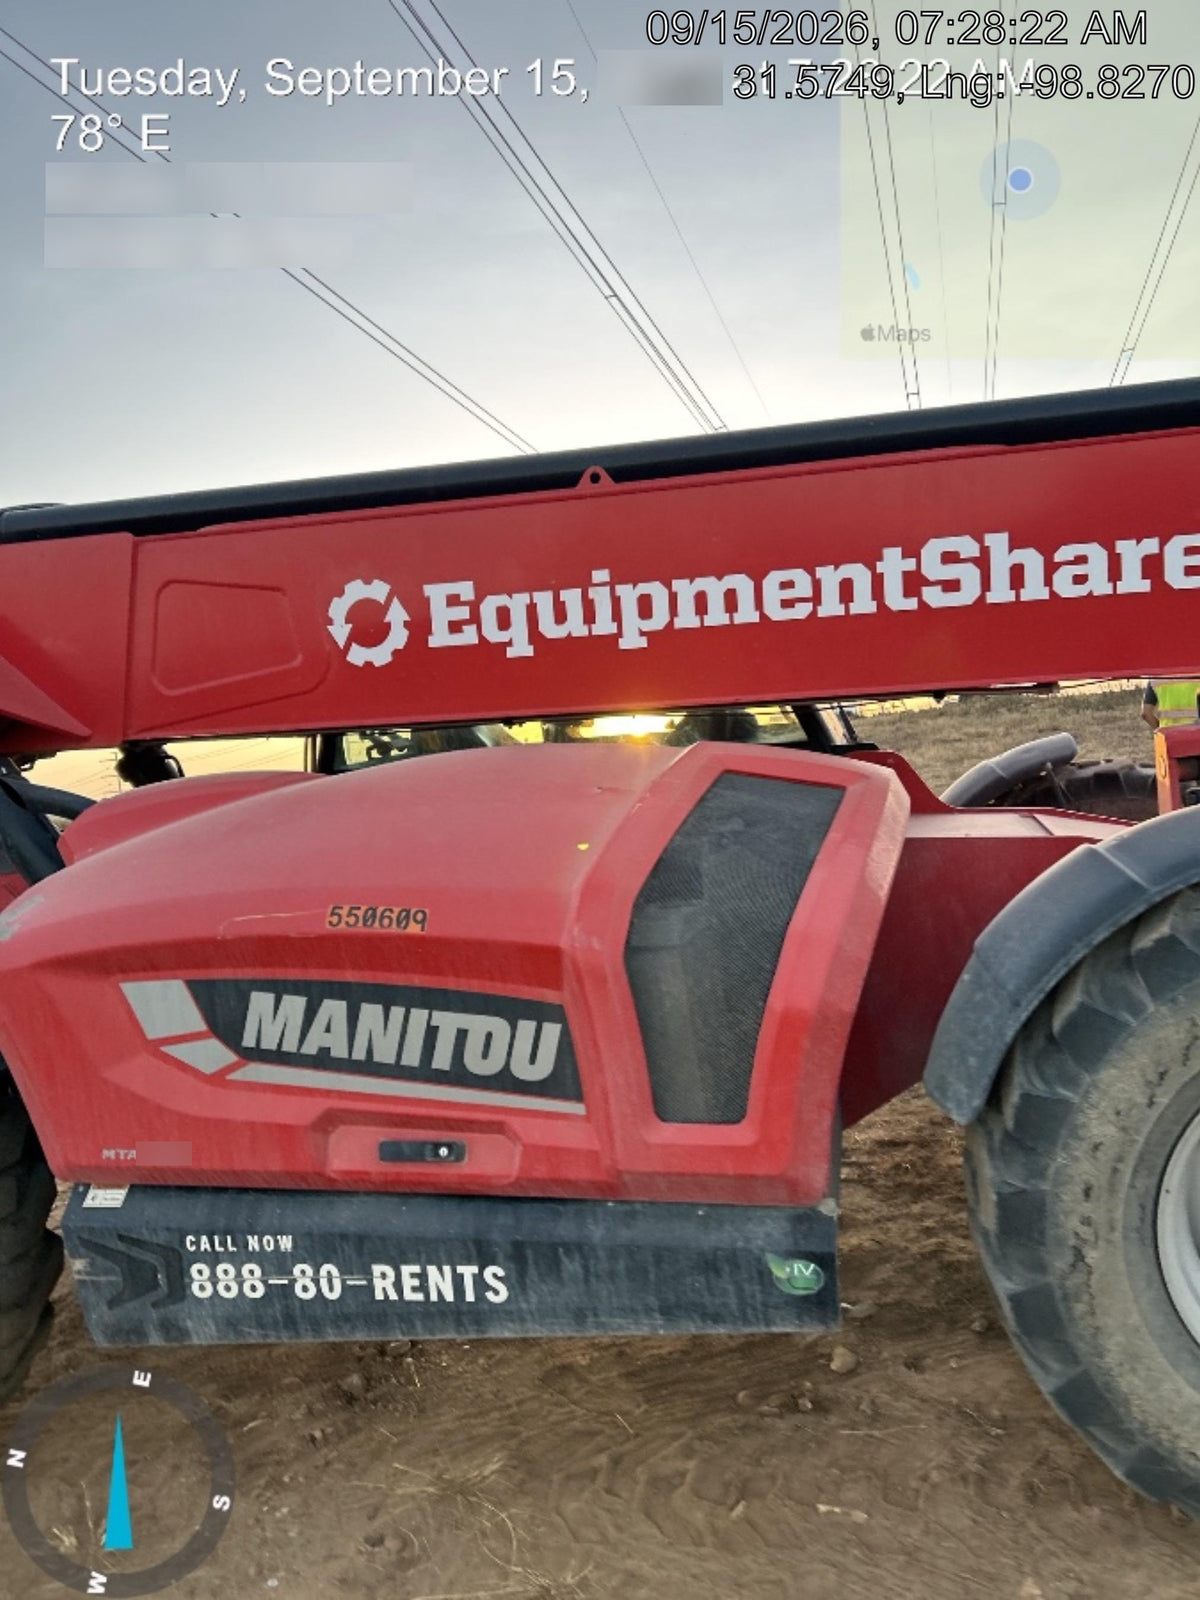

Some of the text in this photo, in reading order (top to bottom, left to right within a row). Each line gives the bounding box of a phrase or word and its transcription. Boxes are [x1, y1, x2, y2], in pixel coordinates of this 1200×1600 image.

[423, 531, 1200, 658] EquipmentShare
[328, 905, 428, 932] 550609
[240, 990, 563, 1082] MANITOU
[185, 1234, 294, 1253] CALL NOW
[189, 1263, 509, 1304] 888-80-RENTS
